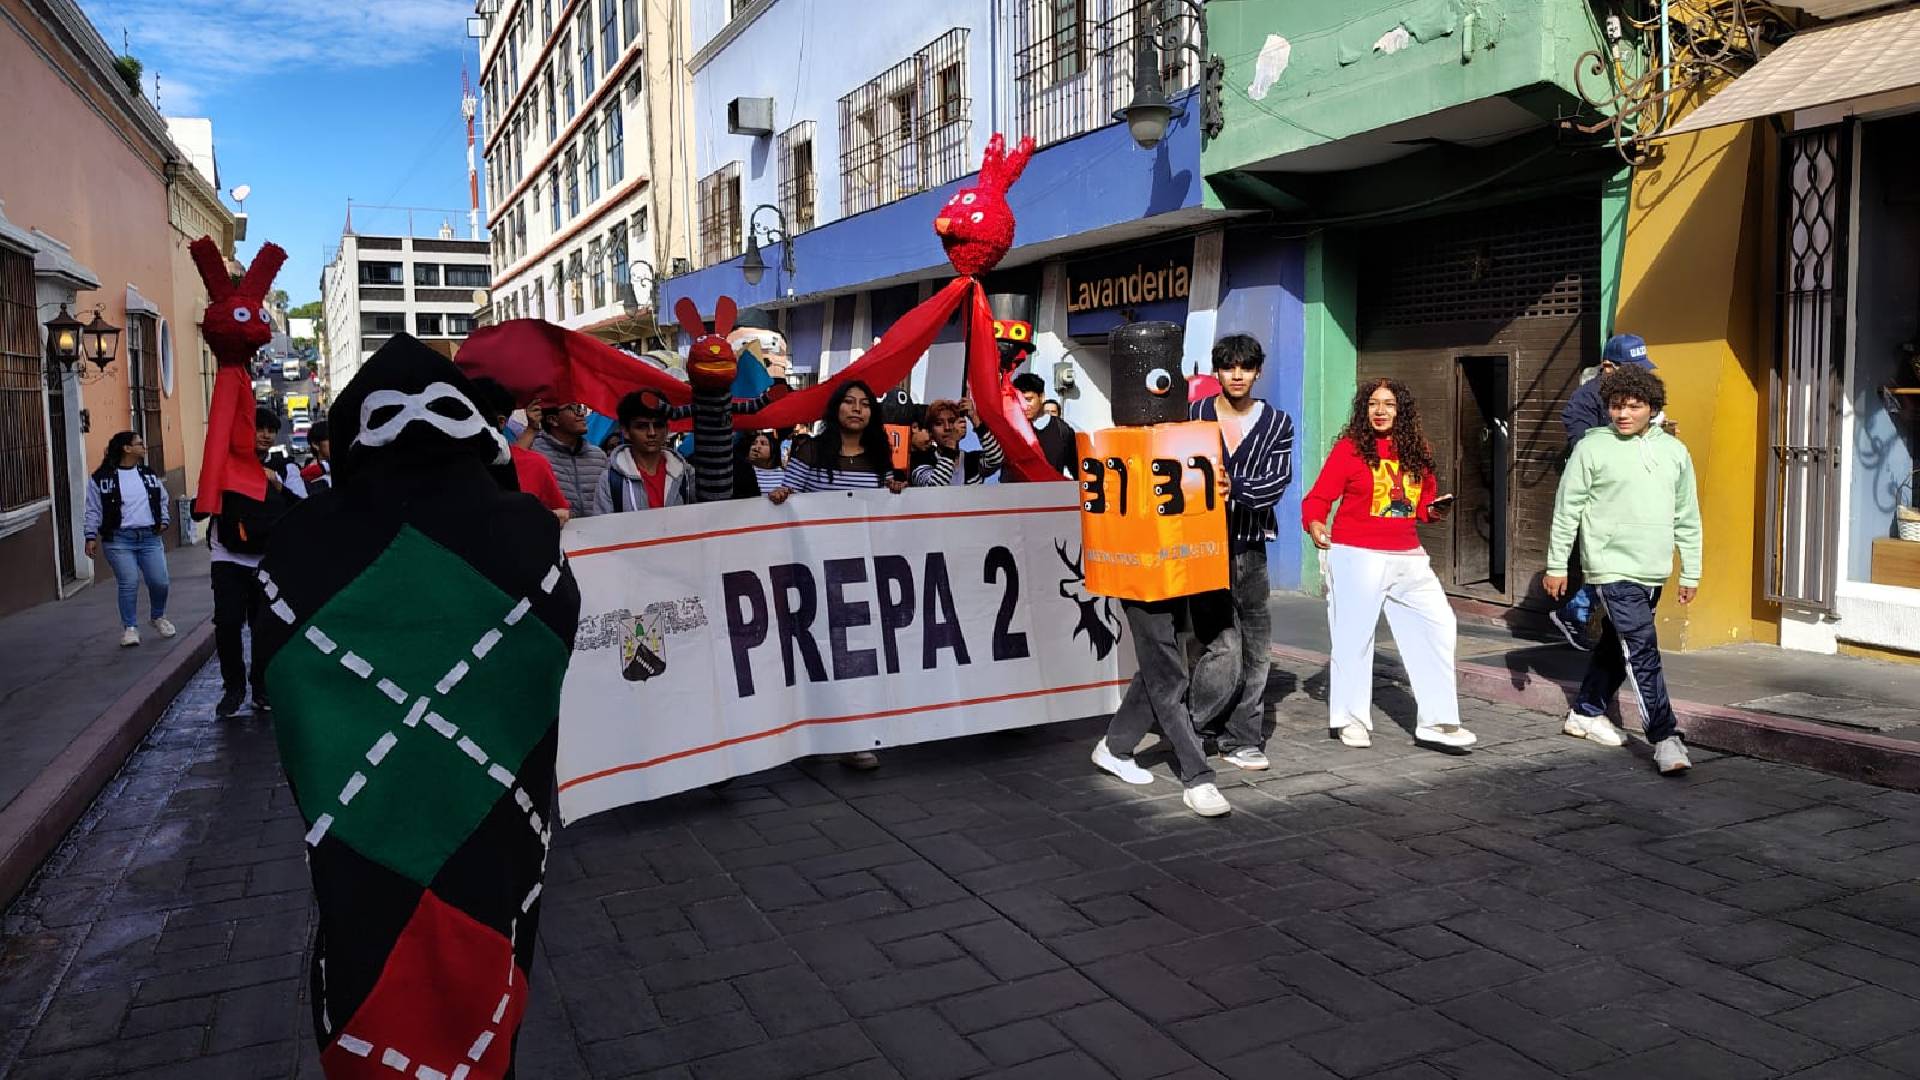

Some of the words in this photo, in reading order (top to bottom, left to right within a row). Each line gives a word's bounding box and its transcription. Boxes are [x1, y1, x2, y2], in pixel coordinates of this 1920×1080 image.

[1066, 260, 1189, 312] Lavanderia
[1151, 455, 1215, 516] 37
[722, 553, 972, 698] PREPA
[983, 545, 1031, 662] 2
